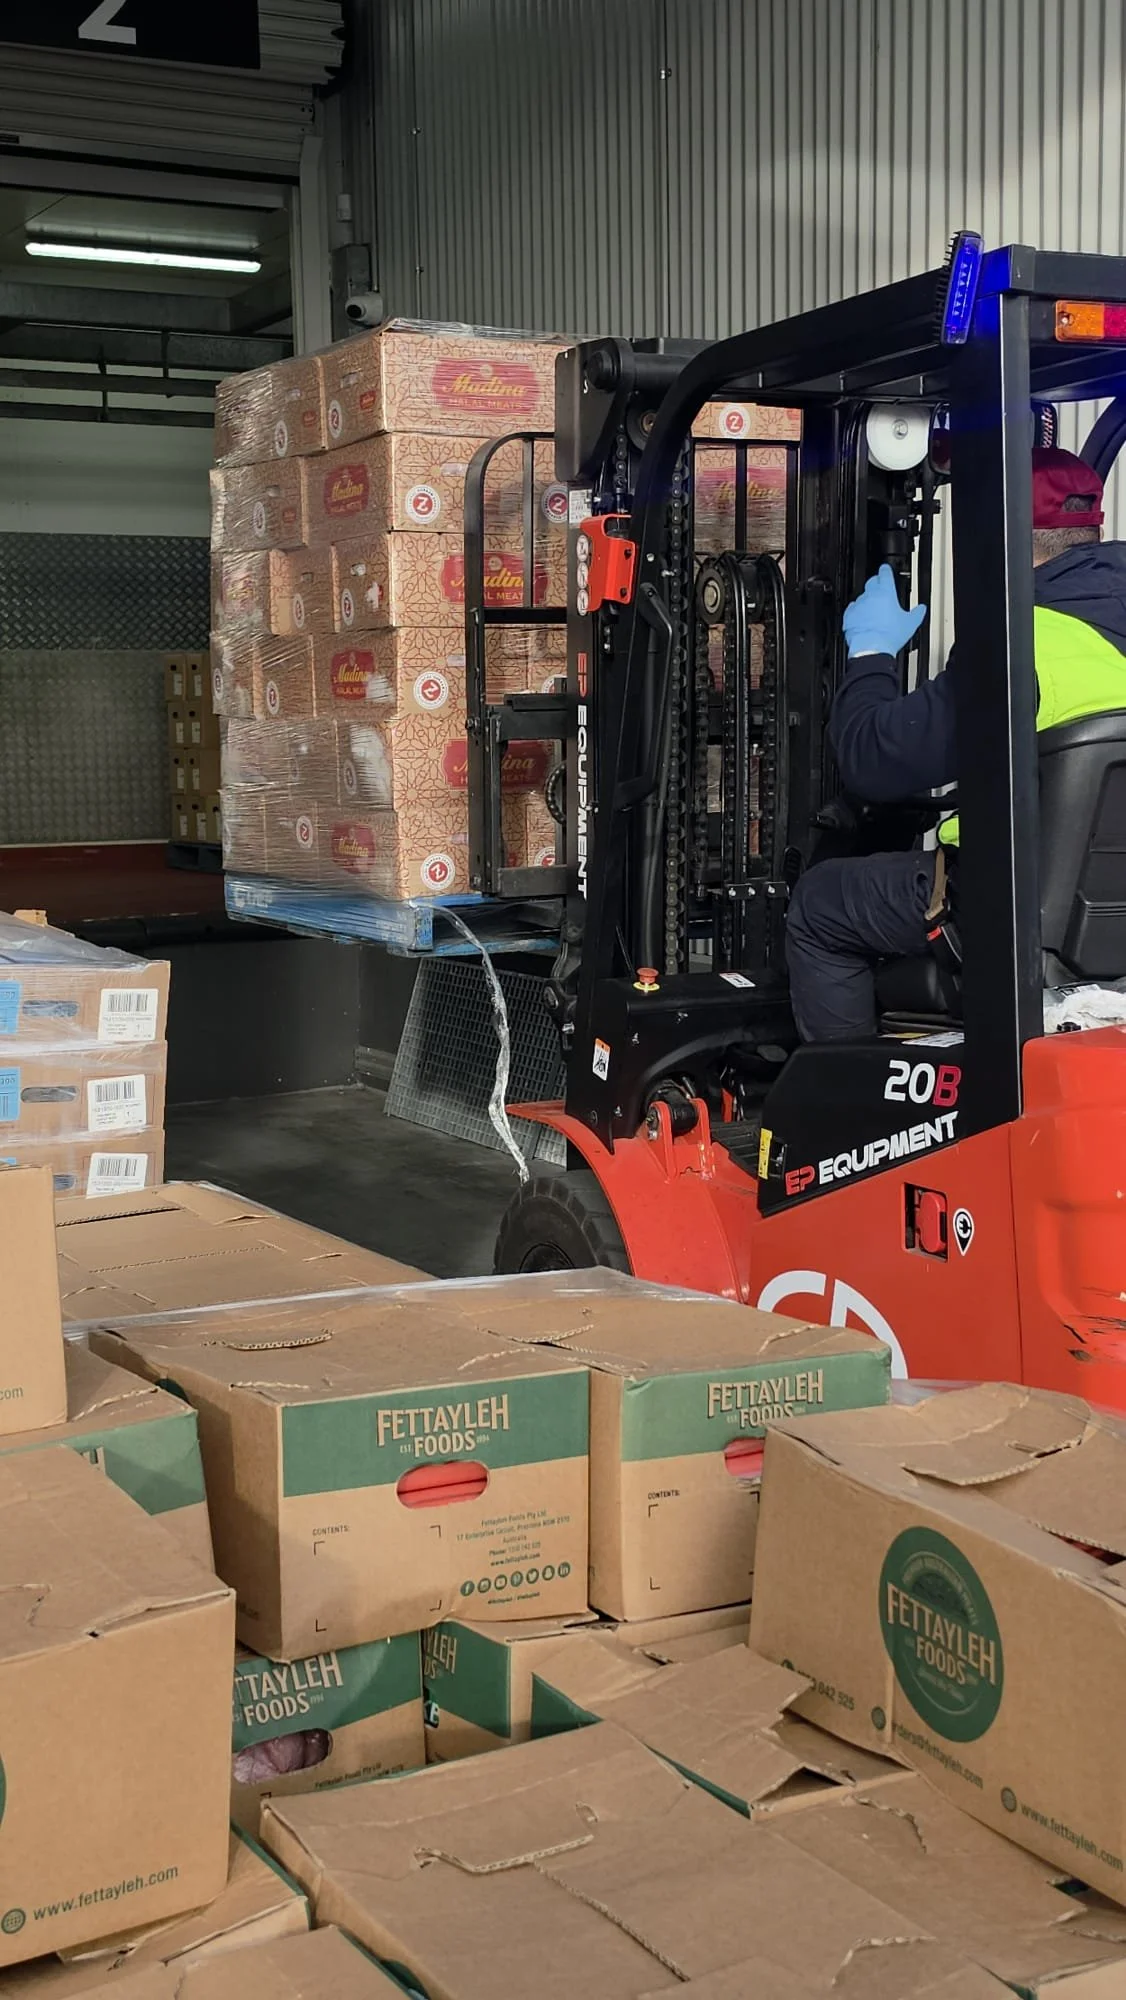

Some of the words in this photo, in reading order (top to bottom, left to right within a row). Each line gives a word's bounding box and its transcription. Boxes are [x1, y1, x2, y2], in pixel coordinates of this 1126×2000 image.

[443, 374, 528, 398] Madina
[577, 653, 588, 698] EP
[577, 705, 588, 901] EQUIPMENT
[884, 1059, 962, 1107] 20B
[785, 1165, 816, 1196] EP
[818, 1110, 959, 1185] EQUIPMENT
[707, 1368, 824, 1418] FETTAYLEH
[740, 1404, 794, 1429] FOODS
[376, 1393, 511, 1448] FETTAYLEH
[414, 1429, 476, 1458] FOODS
[312, 1524, 350, 1537] CONTENTS:
[886, 1580, 997, 1687] FETTAYLEH
[916, 1635, 966, 1686] FOODS
[243, 1692, 310, 1726] FOODS
[1020, 1803, 1124, 1873] www.fettayleh.com
[33, 1865, 179, 1921] www.fettayleh.com
